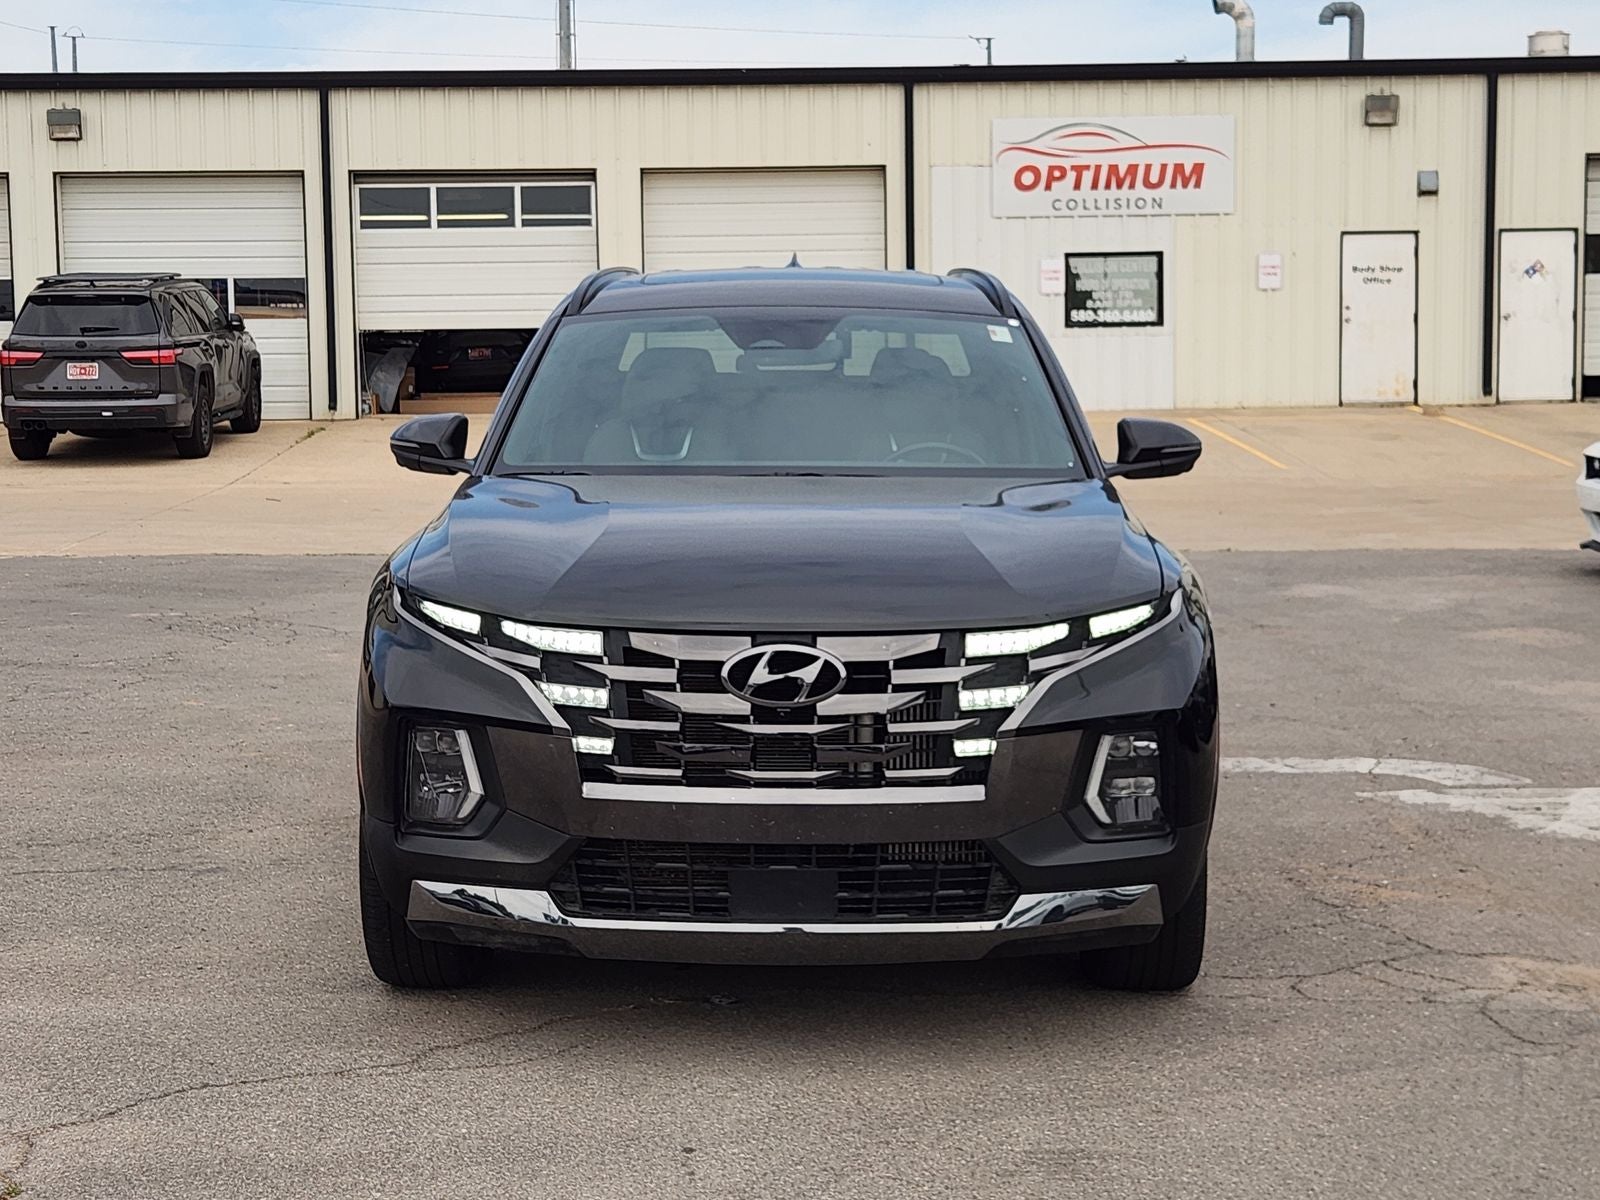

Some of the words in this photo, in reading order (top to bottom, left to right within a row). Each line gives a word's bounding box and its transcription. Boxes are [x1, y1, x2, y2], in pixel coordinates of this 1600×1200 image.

[1014, 162, 1205, 192] OPTIMUM
[1052, 197, 1163, 211] COLLISION
[1352, 265, 1375, 273] Body
[1379, 264, 1403, 273] Shop
[1362, 276, 1391, 284] Office
